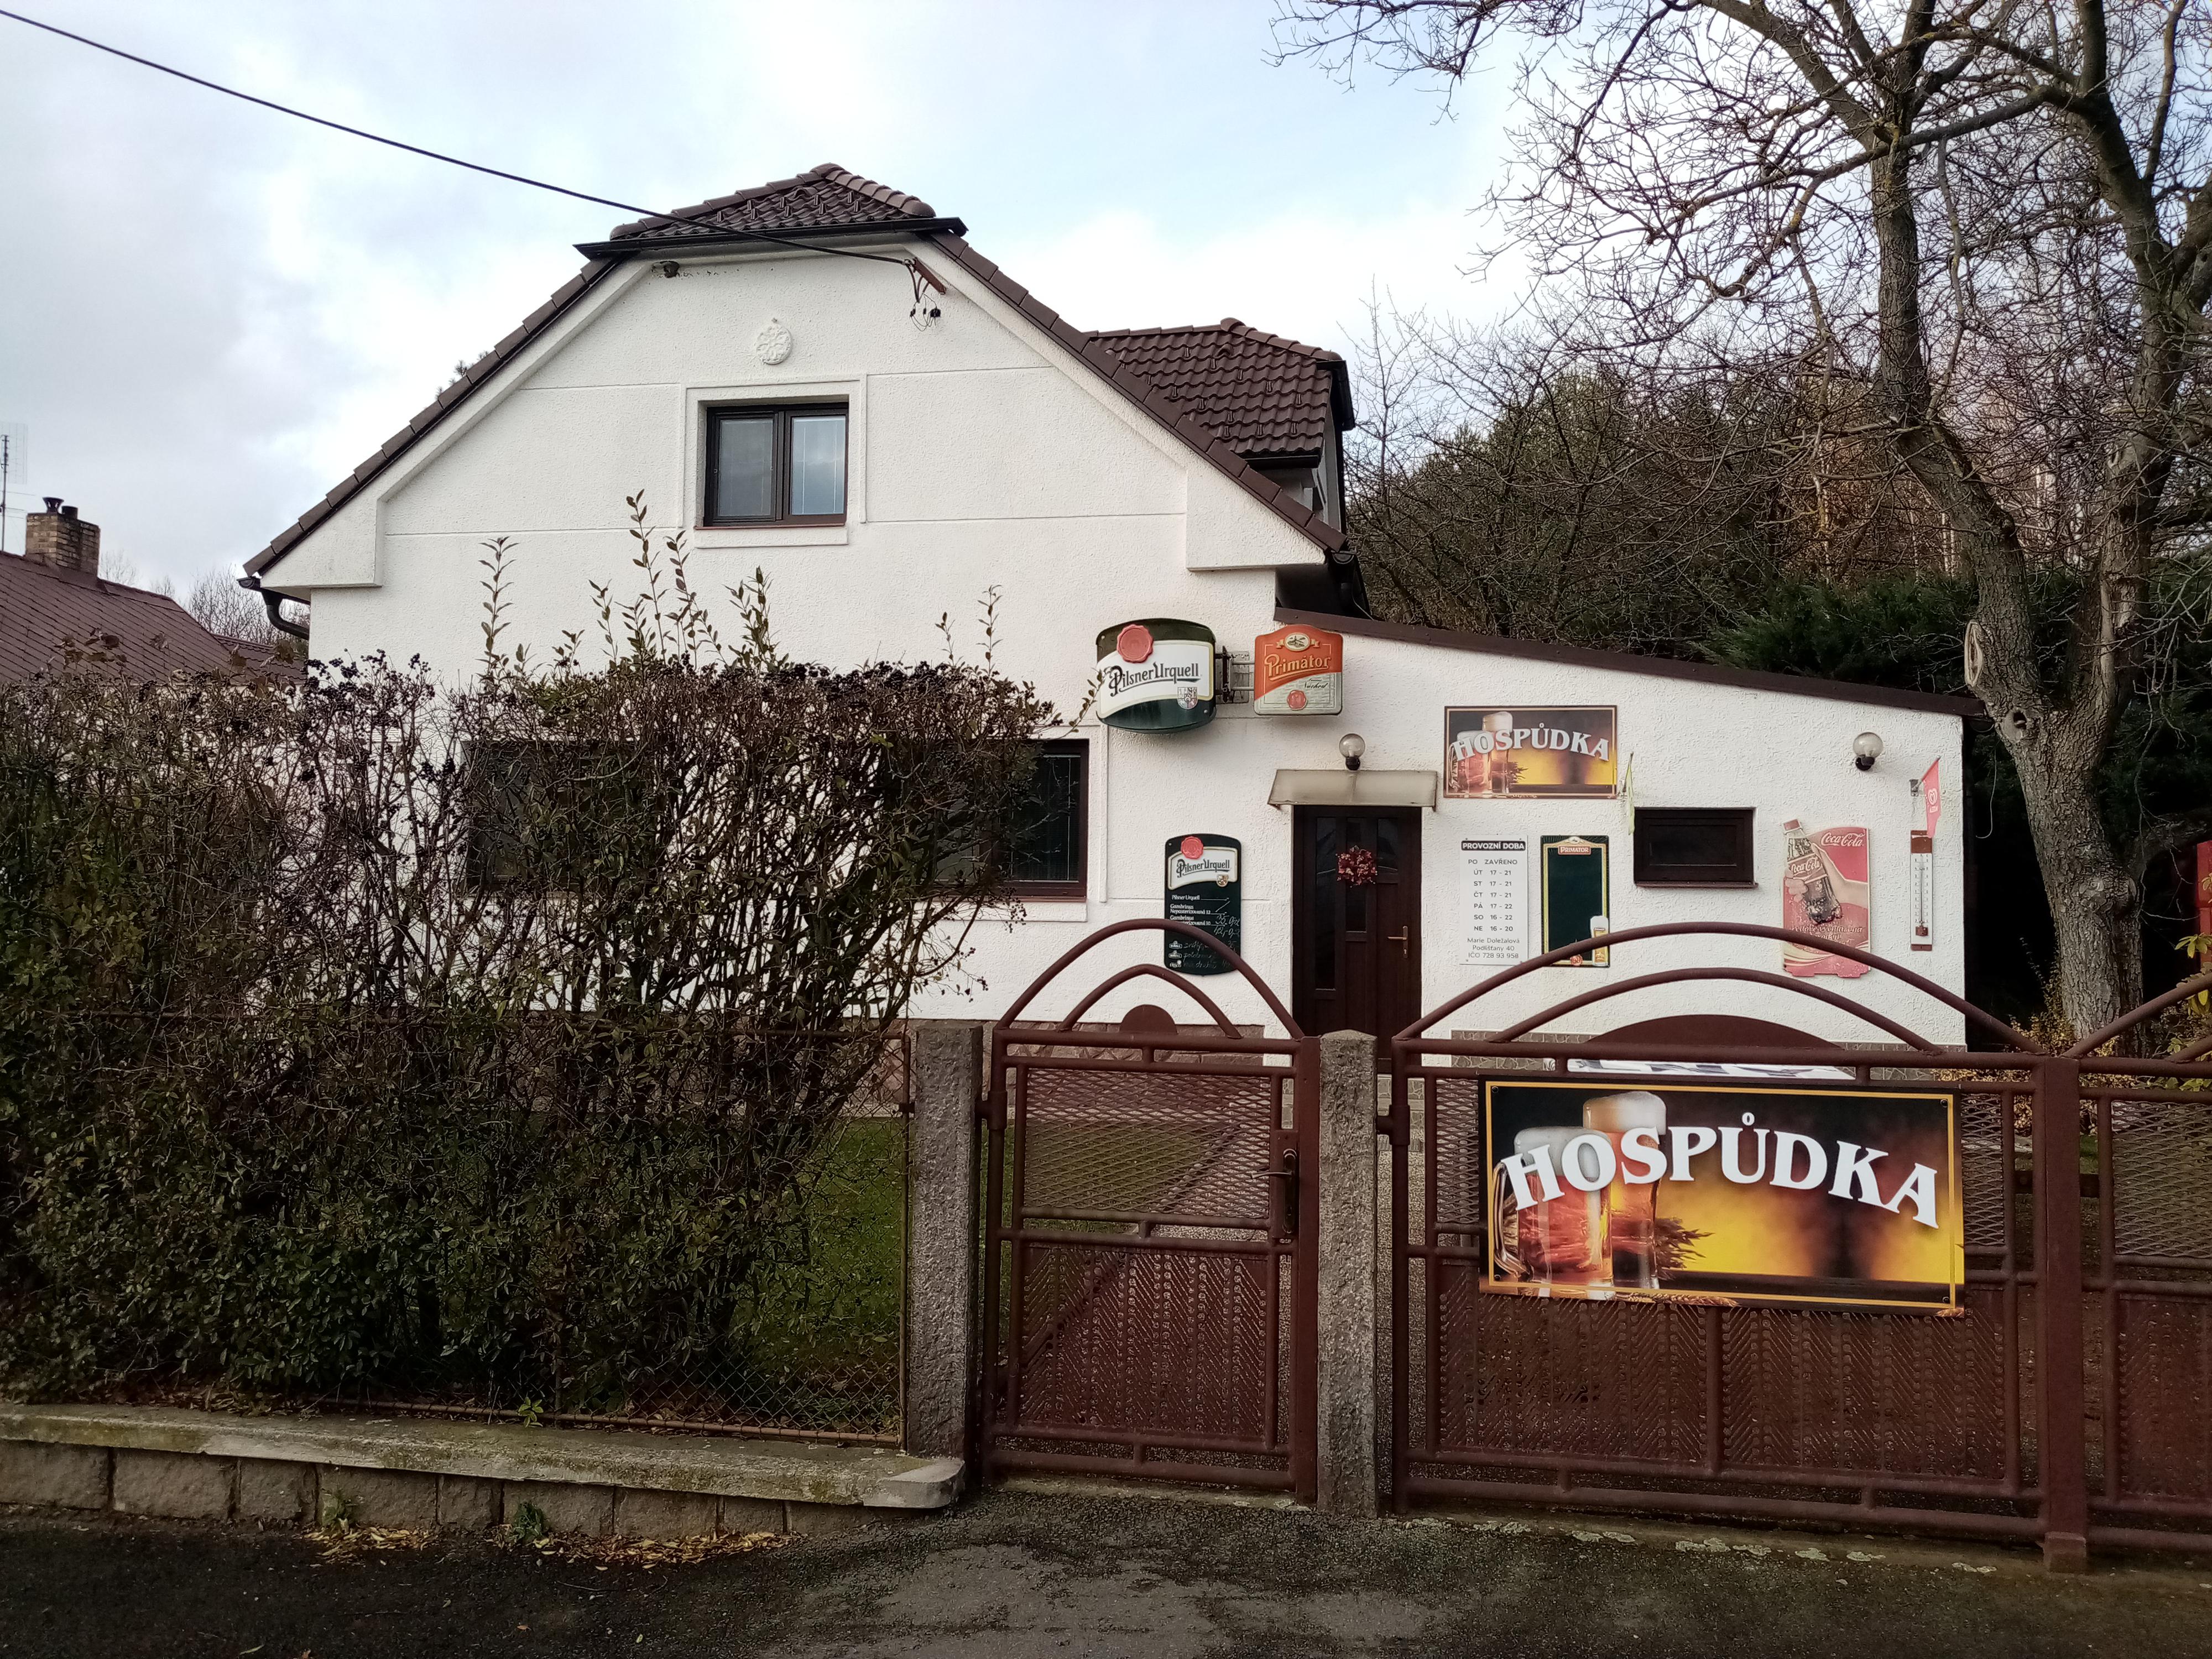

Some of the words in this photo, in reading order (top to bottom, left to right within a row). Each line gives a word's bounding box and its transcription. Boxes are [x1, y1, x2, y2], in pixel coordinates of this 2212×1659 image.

[1108, 665, 1155, 697] Pilsner
[1154, 661, 1199, 684] Urquell
[1264, 653, 1332, 677] Primátor
[1452, 722, 1609, 761] HOSPŮDKA
[1176, 858, 1204, 878] Pilsner
[1203, 859, 1230, 872] Urquell
[1500, 1112, 1940, 1230] HOSPŮDKA
